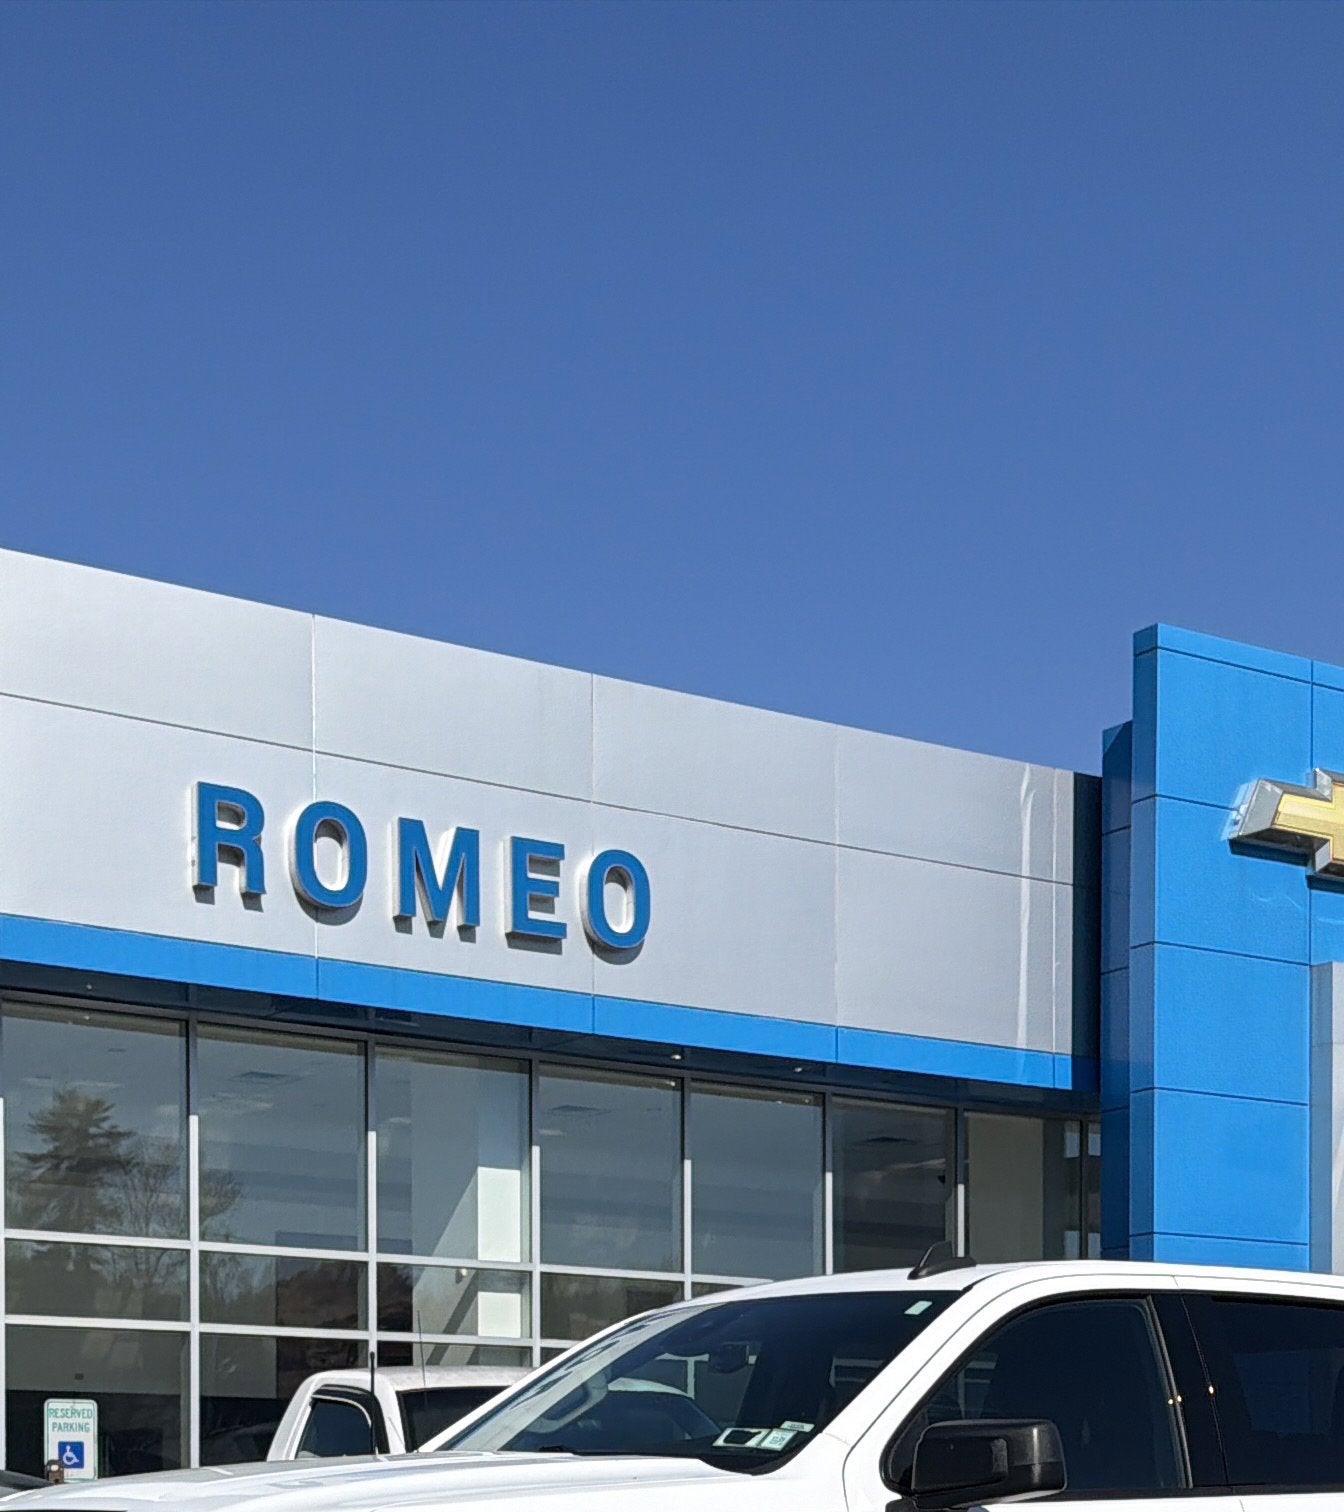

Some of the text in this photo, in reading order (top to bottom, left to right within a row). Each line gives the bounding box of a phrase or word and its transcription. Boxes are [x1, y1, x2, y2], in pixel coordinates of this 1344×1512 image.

[193, 781, 652, 950] ROMEO
[48, 1408, 94, 1419] RESERVED
[52, 1422, 91, 1433] PARKING
